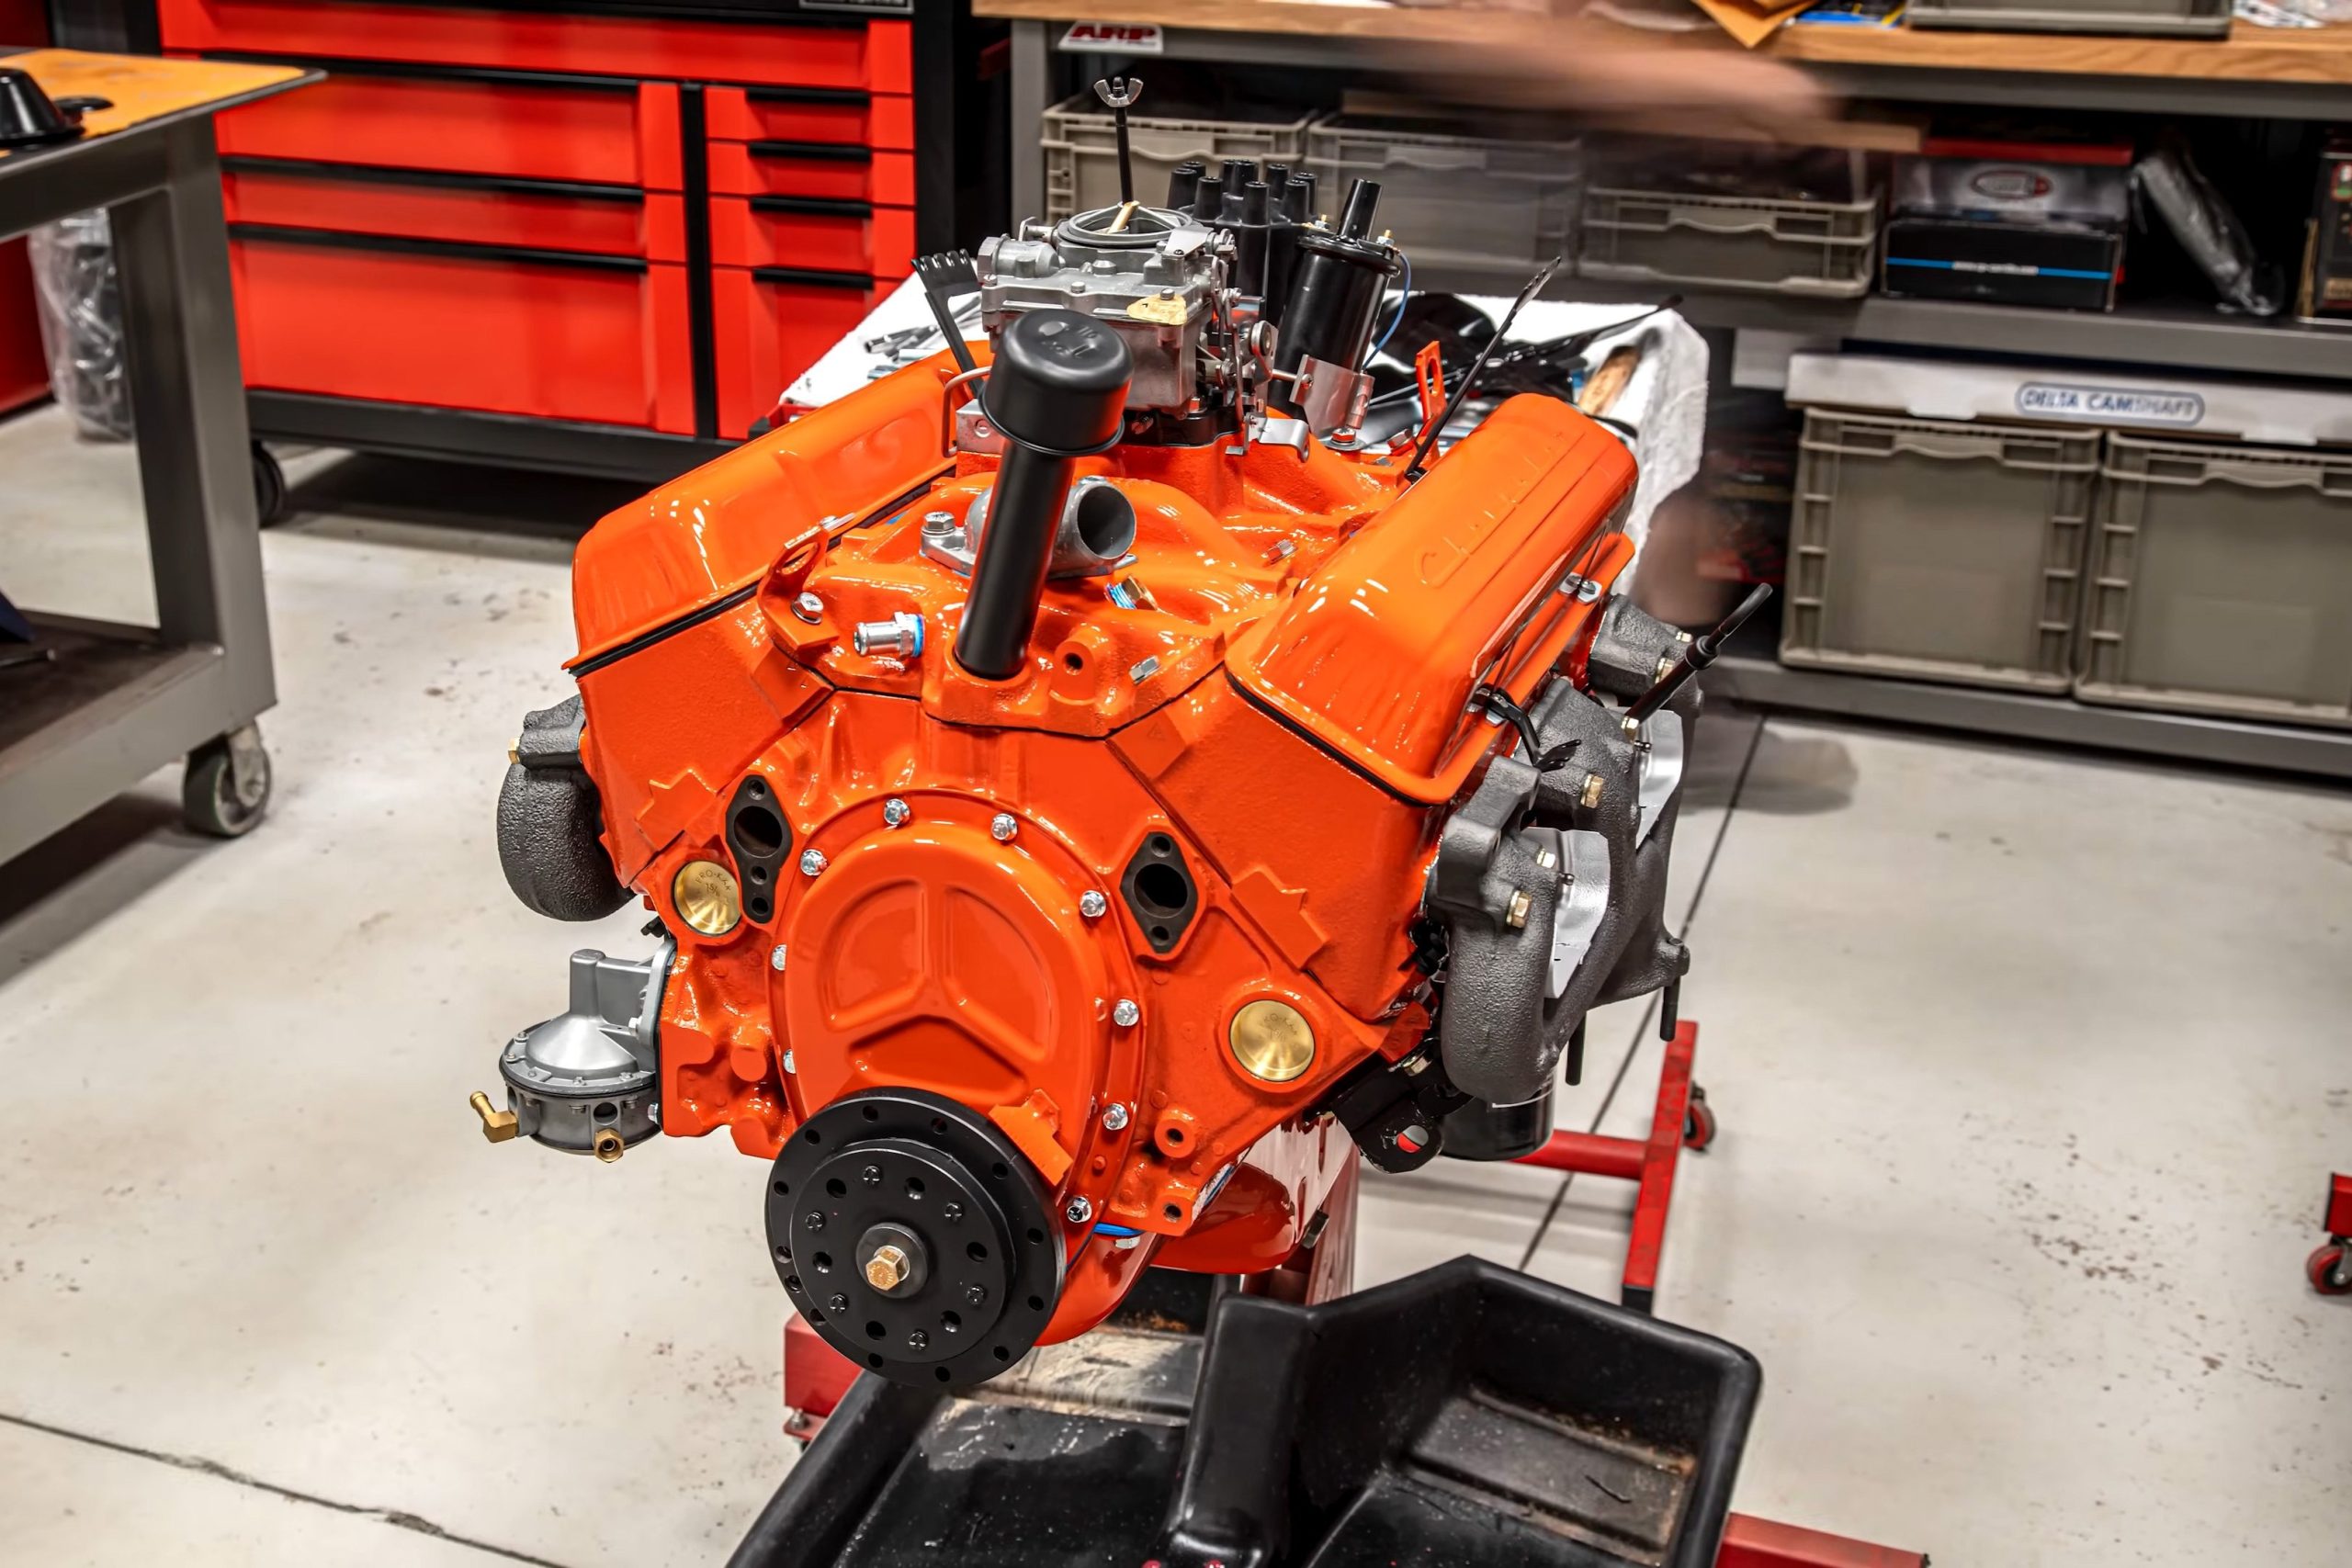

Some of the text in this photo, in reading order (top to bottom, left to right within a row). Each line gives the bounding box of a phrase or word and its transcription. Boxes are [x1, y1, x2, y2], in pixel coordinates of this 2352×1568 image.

[1069, 25, 1158, 45] ARP
[2024, 389, 2194, 414] DELTA CAMSHAFT
